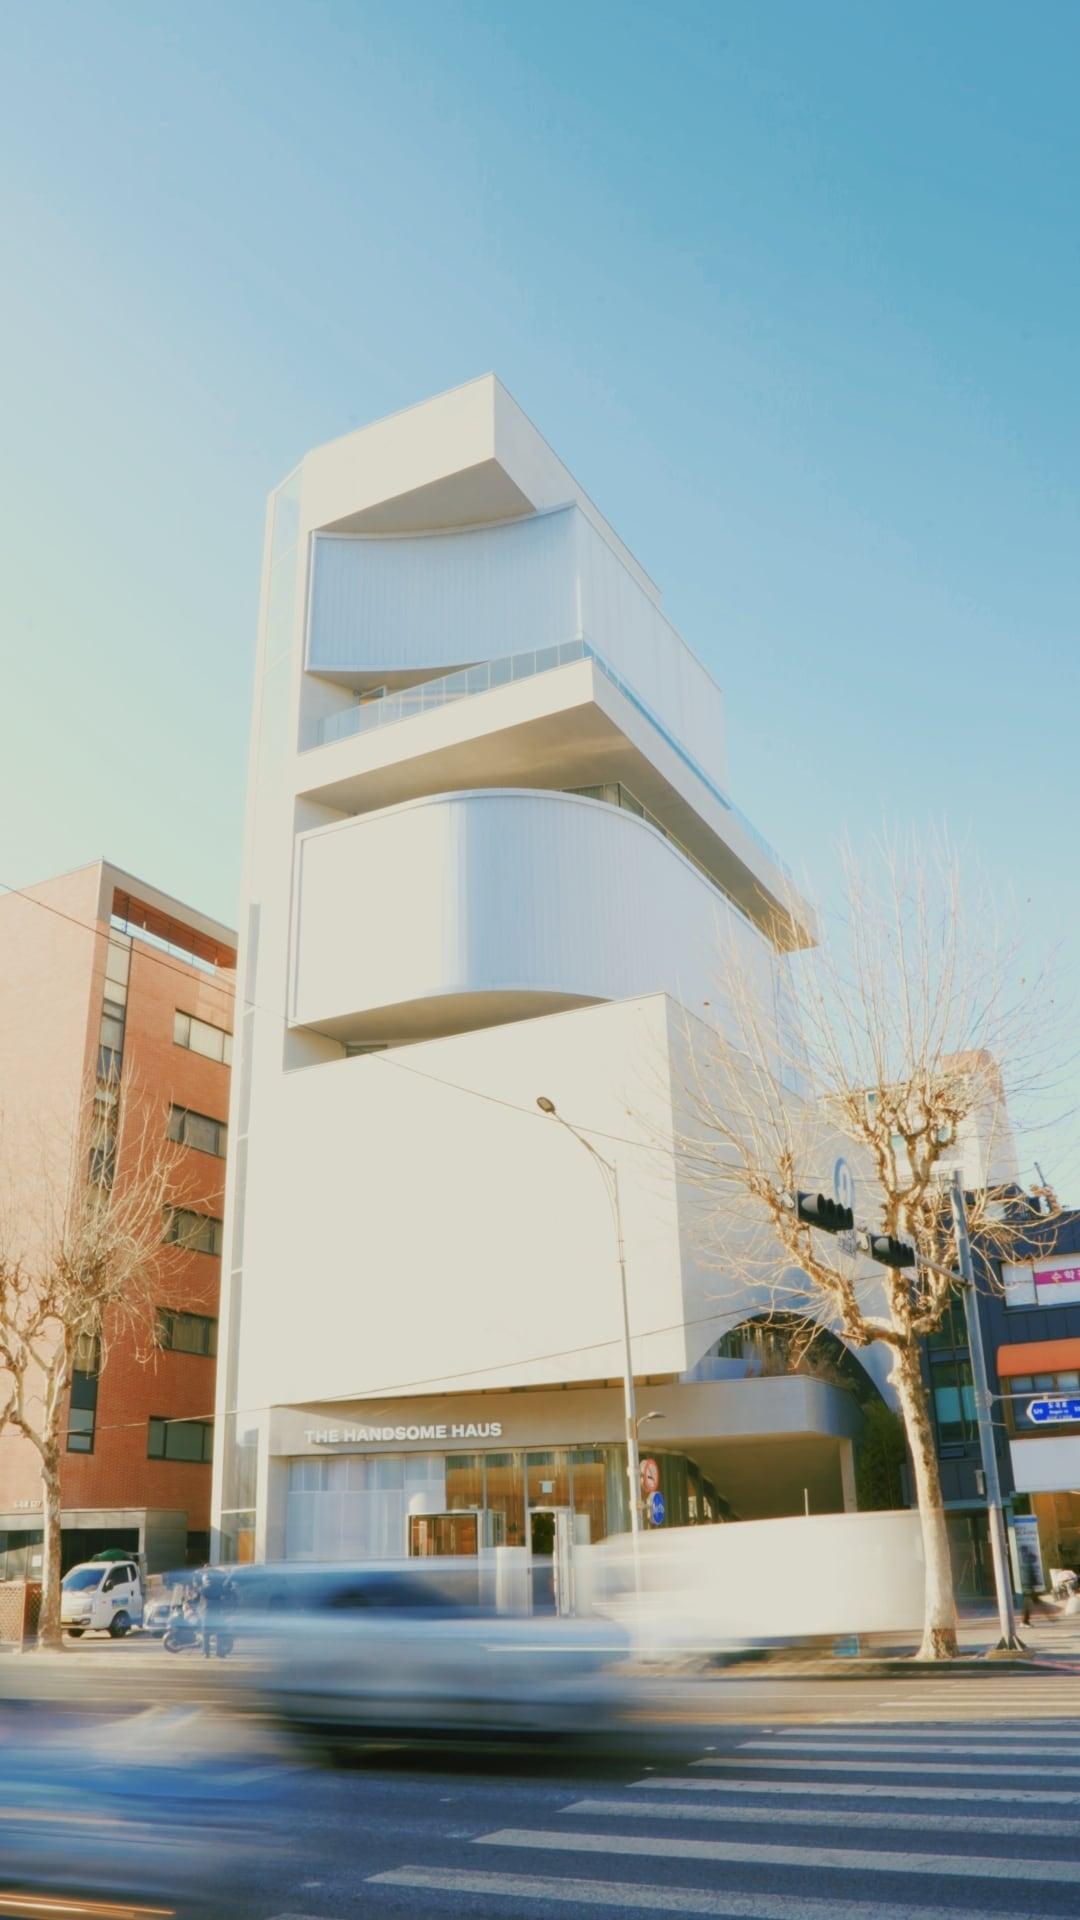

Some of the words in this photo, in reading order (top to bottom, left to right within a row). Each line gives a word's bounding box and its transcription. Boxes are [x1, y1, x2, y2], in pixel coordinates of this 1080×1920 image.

[304, 1430, 339, 1443] THE
[343, 1425, 448, 1441] HANDSOME
[451, 1422, 502, 1438] HAUS
